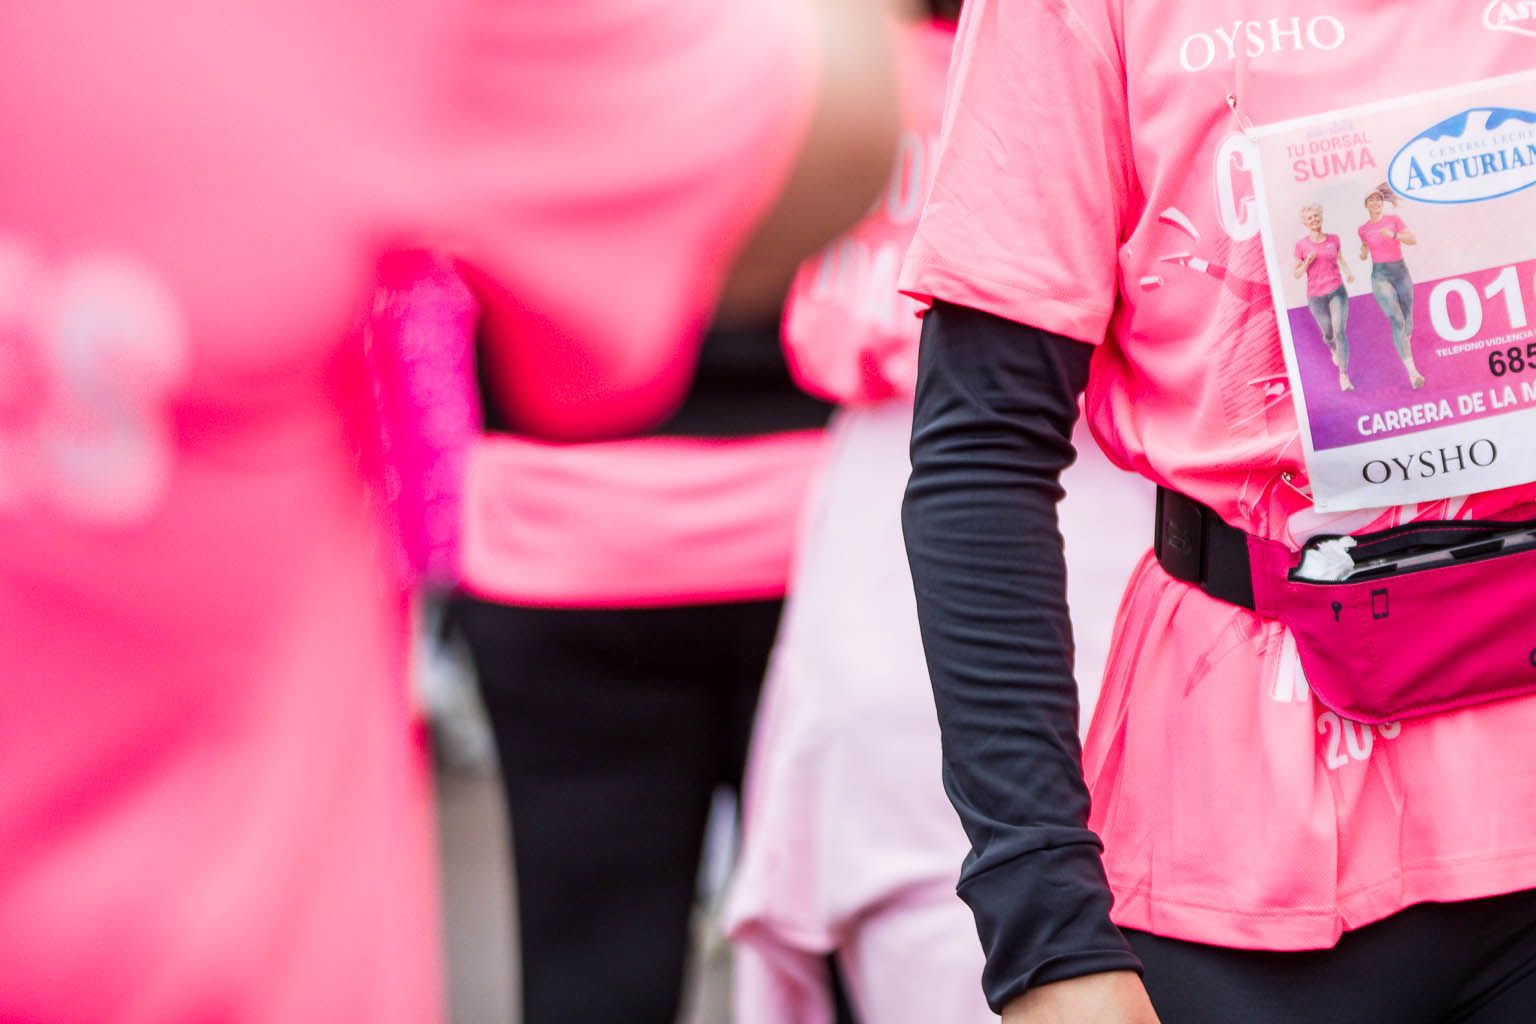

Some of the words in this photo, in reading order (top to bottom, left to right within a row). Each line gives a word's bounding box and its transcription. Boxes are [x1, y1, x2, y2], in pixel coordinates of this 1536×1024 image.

[1179, 14, 1346, 73] OYSHO
[1286, 142, 1305, 160] TU
[1309, 130, 1373, 155] DORSAL
[1293, 147, 1376, 183] SUMA
[1357, 399, 1454, 436] CARRERA
[1458, 392, 1486, 417] DE
[1491, 385, 1517, 409] LA
[1362, 438, 1499, 485] OYSHO
[1317, 711, 1402, 770] 20
